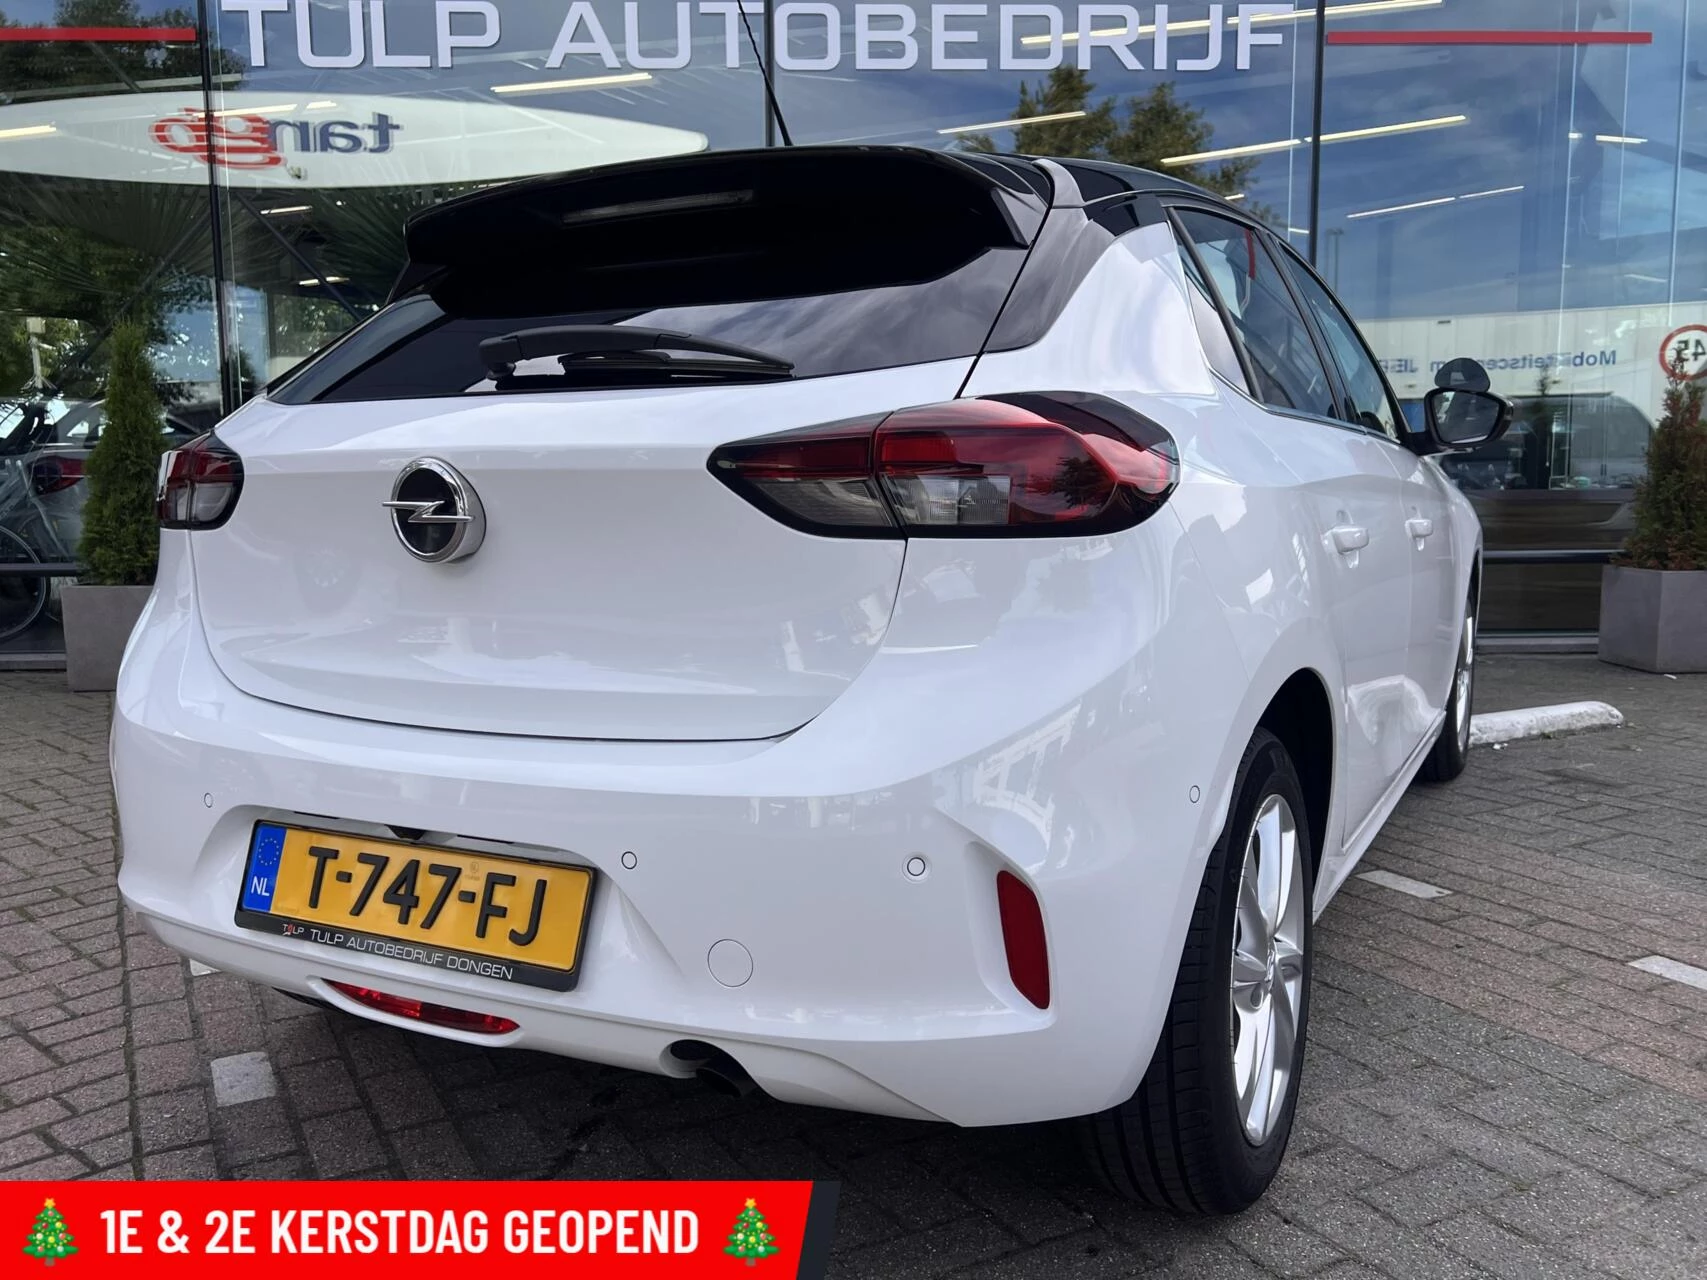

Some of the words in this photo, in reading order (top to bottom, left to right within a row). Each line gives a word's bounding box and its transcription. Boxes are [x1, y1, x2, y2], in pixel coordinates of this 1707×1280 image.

[221, 0, 500, 68] TULP
[545, 0, 1294, 70] AUTOBEDRIJF
[251, 875, 271, 897] NL
[308, 846, 548, 947] T-747-FJ
[310, 928, 344, 945] TULP
[346, 936, 444, 966] AUTOBEDRIJF
[446, 955, 514, 981] DONGEN
